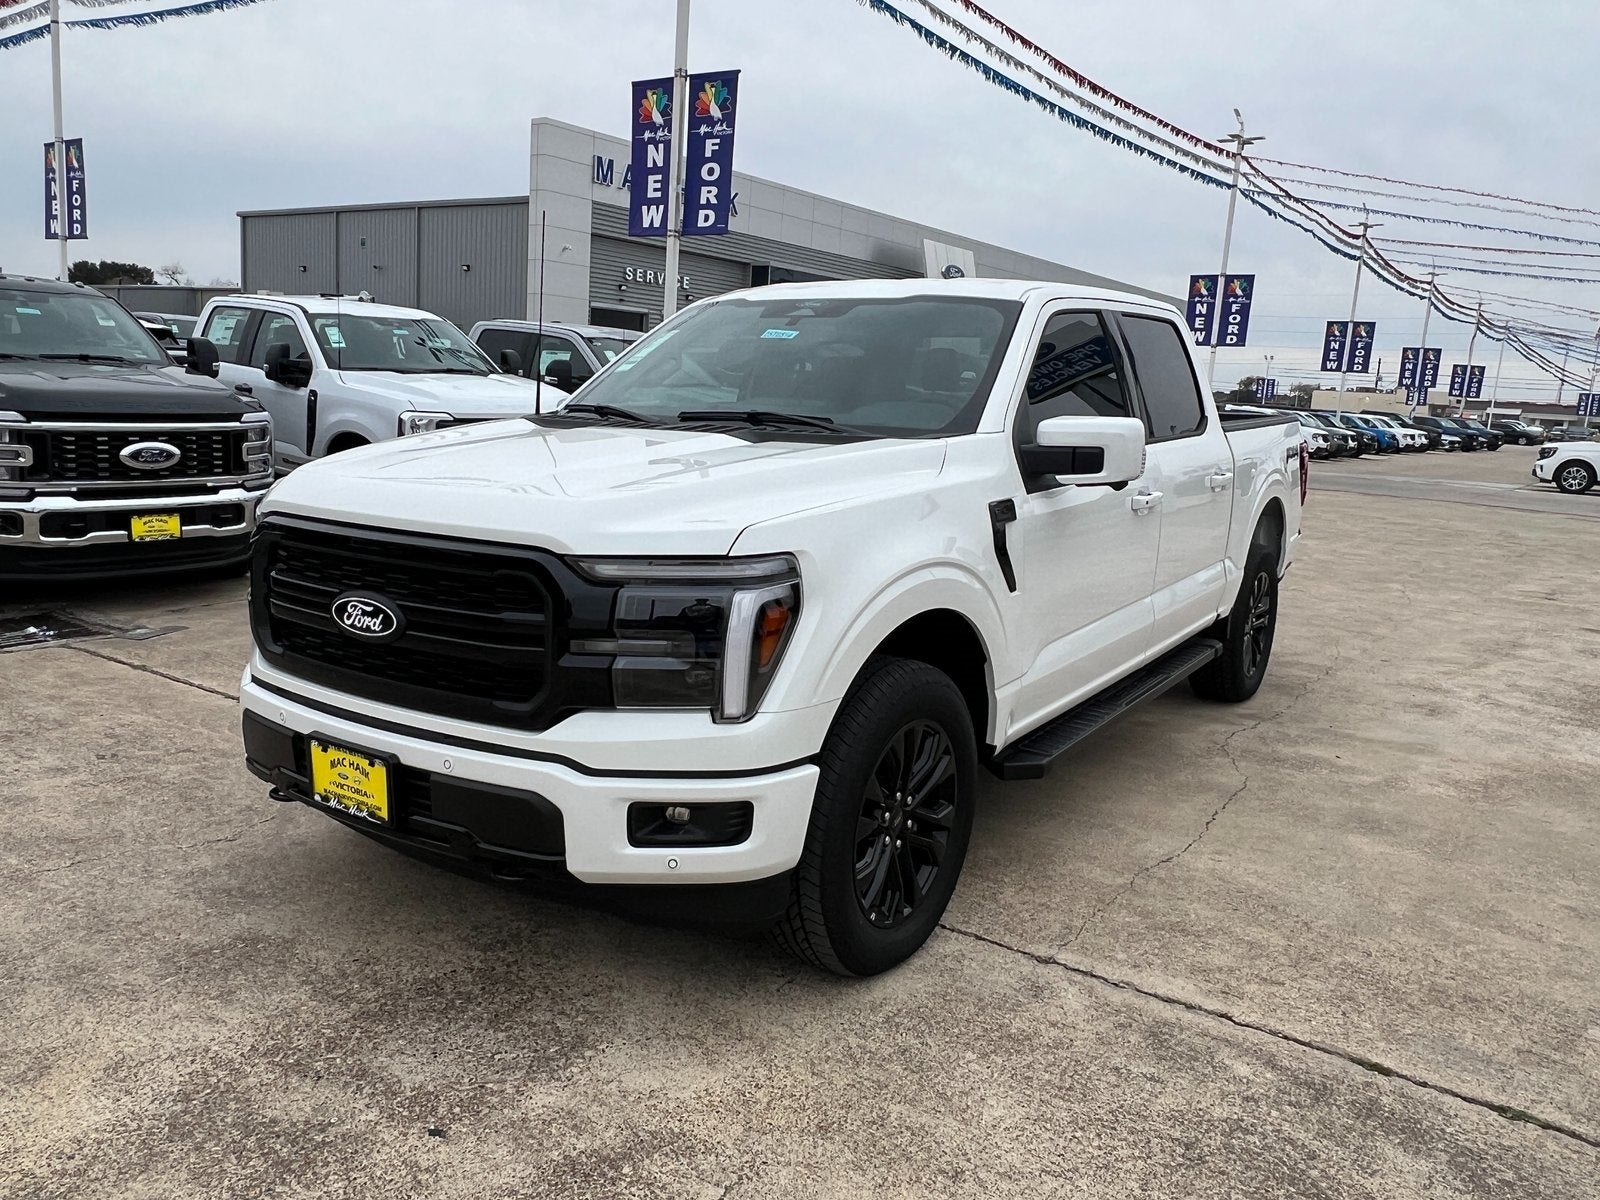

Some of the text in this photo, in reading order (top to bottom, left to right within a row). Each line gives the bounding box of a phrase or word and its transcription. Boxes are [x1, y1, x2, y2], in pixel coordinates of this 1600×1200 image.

[592, 154, 632, 190] MA
[641, 143, 664, 228] NEW
[697, 138, 721, 228] FORD
[72, 180, 81, 235] FORD
[625, 267, 690, 289] SERVE
[1190, 303, 1207, 342] NEW
[1225, 303, 1241, 344] FORD
[1326, 341, 1340, 370] NEW
[1353, 342, 1365, 371] FORD
[1402, 363, 1413, 385] NEW
[1424, 364, 1433, 387] FORD
[139, 450, 167, 462] Ford
[343, 601, 384, 632] Ford
[330, 757, 346, 770] MAC
[325, 797, 347, 810] Mac
